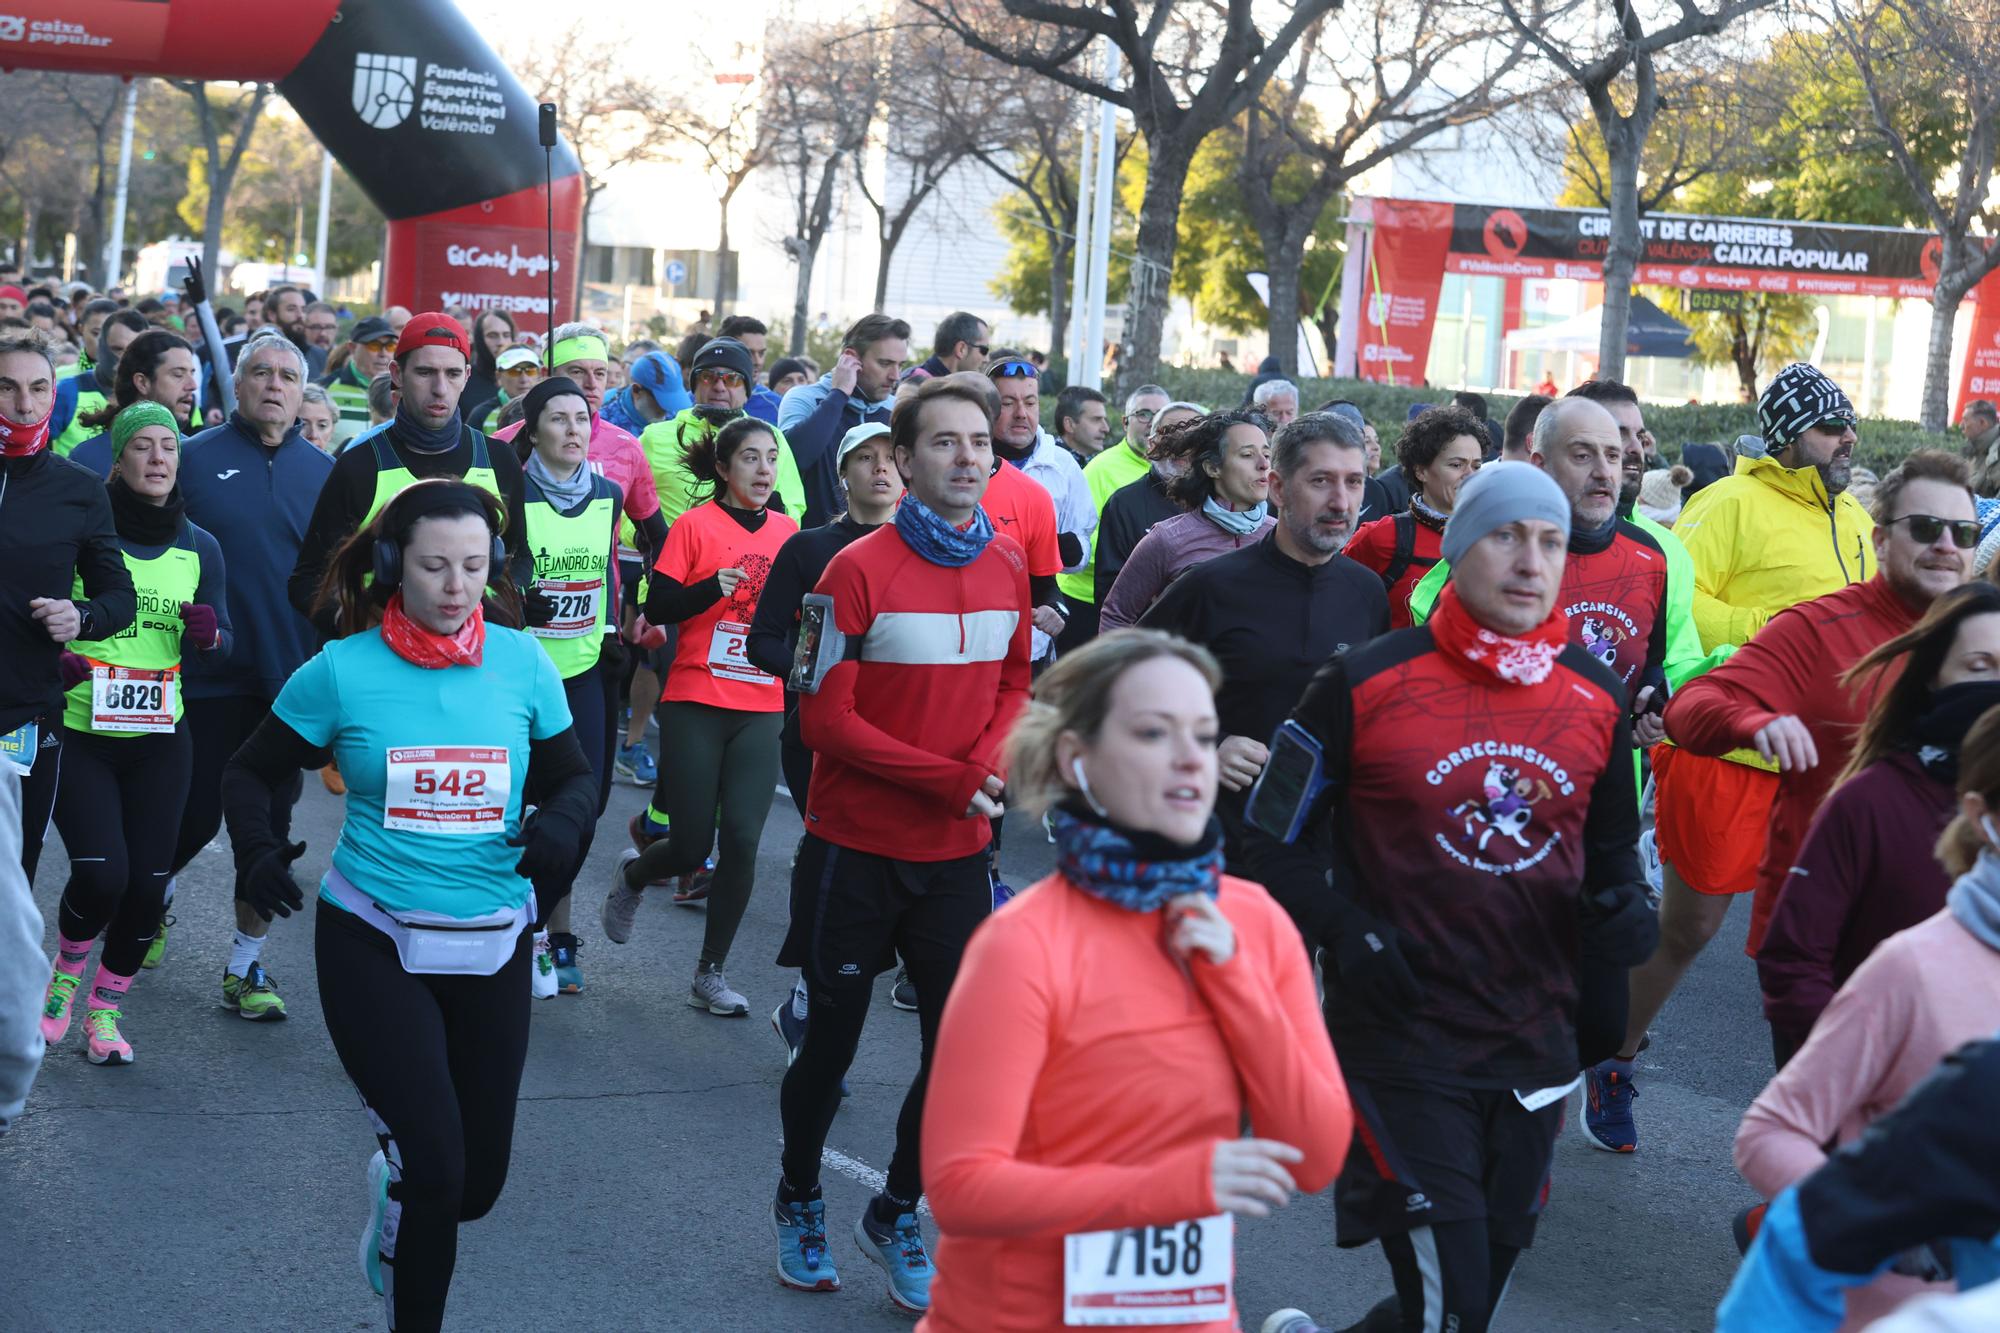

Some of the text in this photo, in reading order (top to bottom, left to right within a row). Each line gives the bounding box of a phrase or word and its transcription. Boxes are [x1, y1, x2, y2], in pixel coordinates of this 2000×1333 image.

[31, 19, 84, 34] caixa
[28, 31, 113, 47] popular
[424, 63, 498, 87] Fundació
[423, 80, 503, 104] Esportiva
[421, 97, 507, 124] Municipal
[420, 113, 496, 135] València
[1660, 221, 1687, 241] DE
[1688, 223, 1794, 248] CARRERES
[564, 547, 589, 555] CLÍNICA
[137, 587, 158, 595] ÍNICA
[547, 593, 592, 619] 5278
[105, 683, 163, 711] 6829
[1425, 740, 1575, 797] CORRECANSINOS
[414, 769, 487, 796] 542
